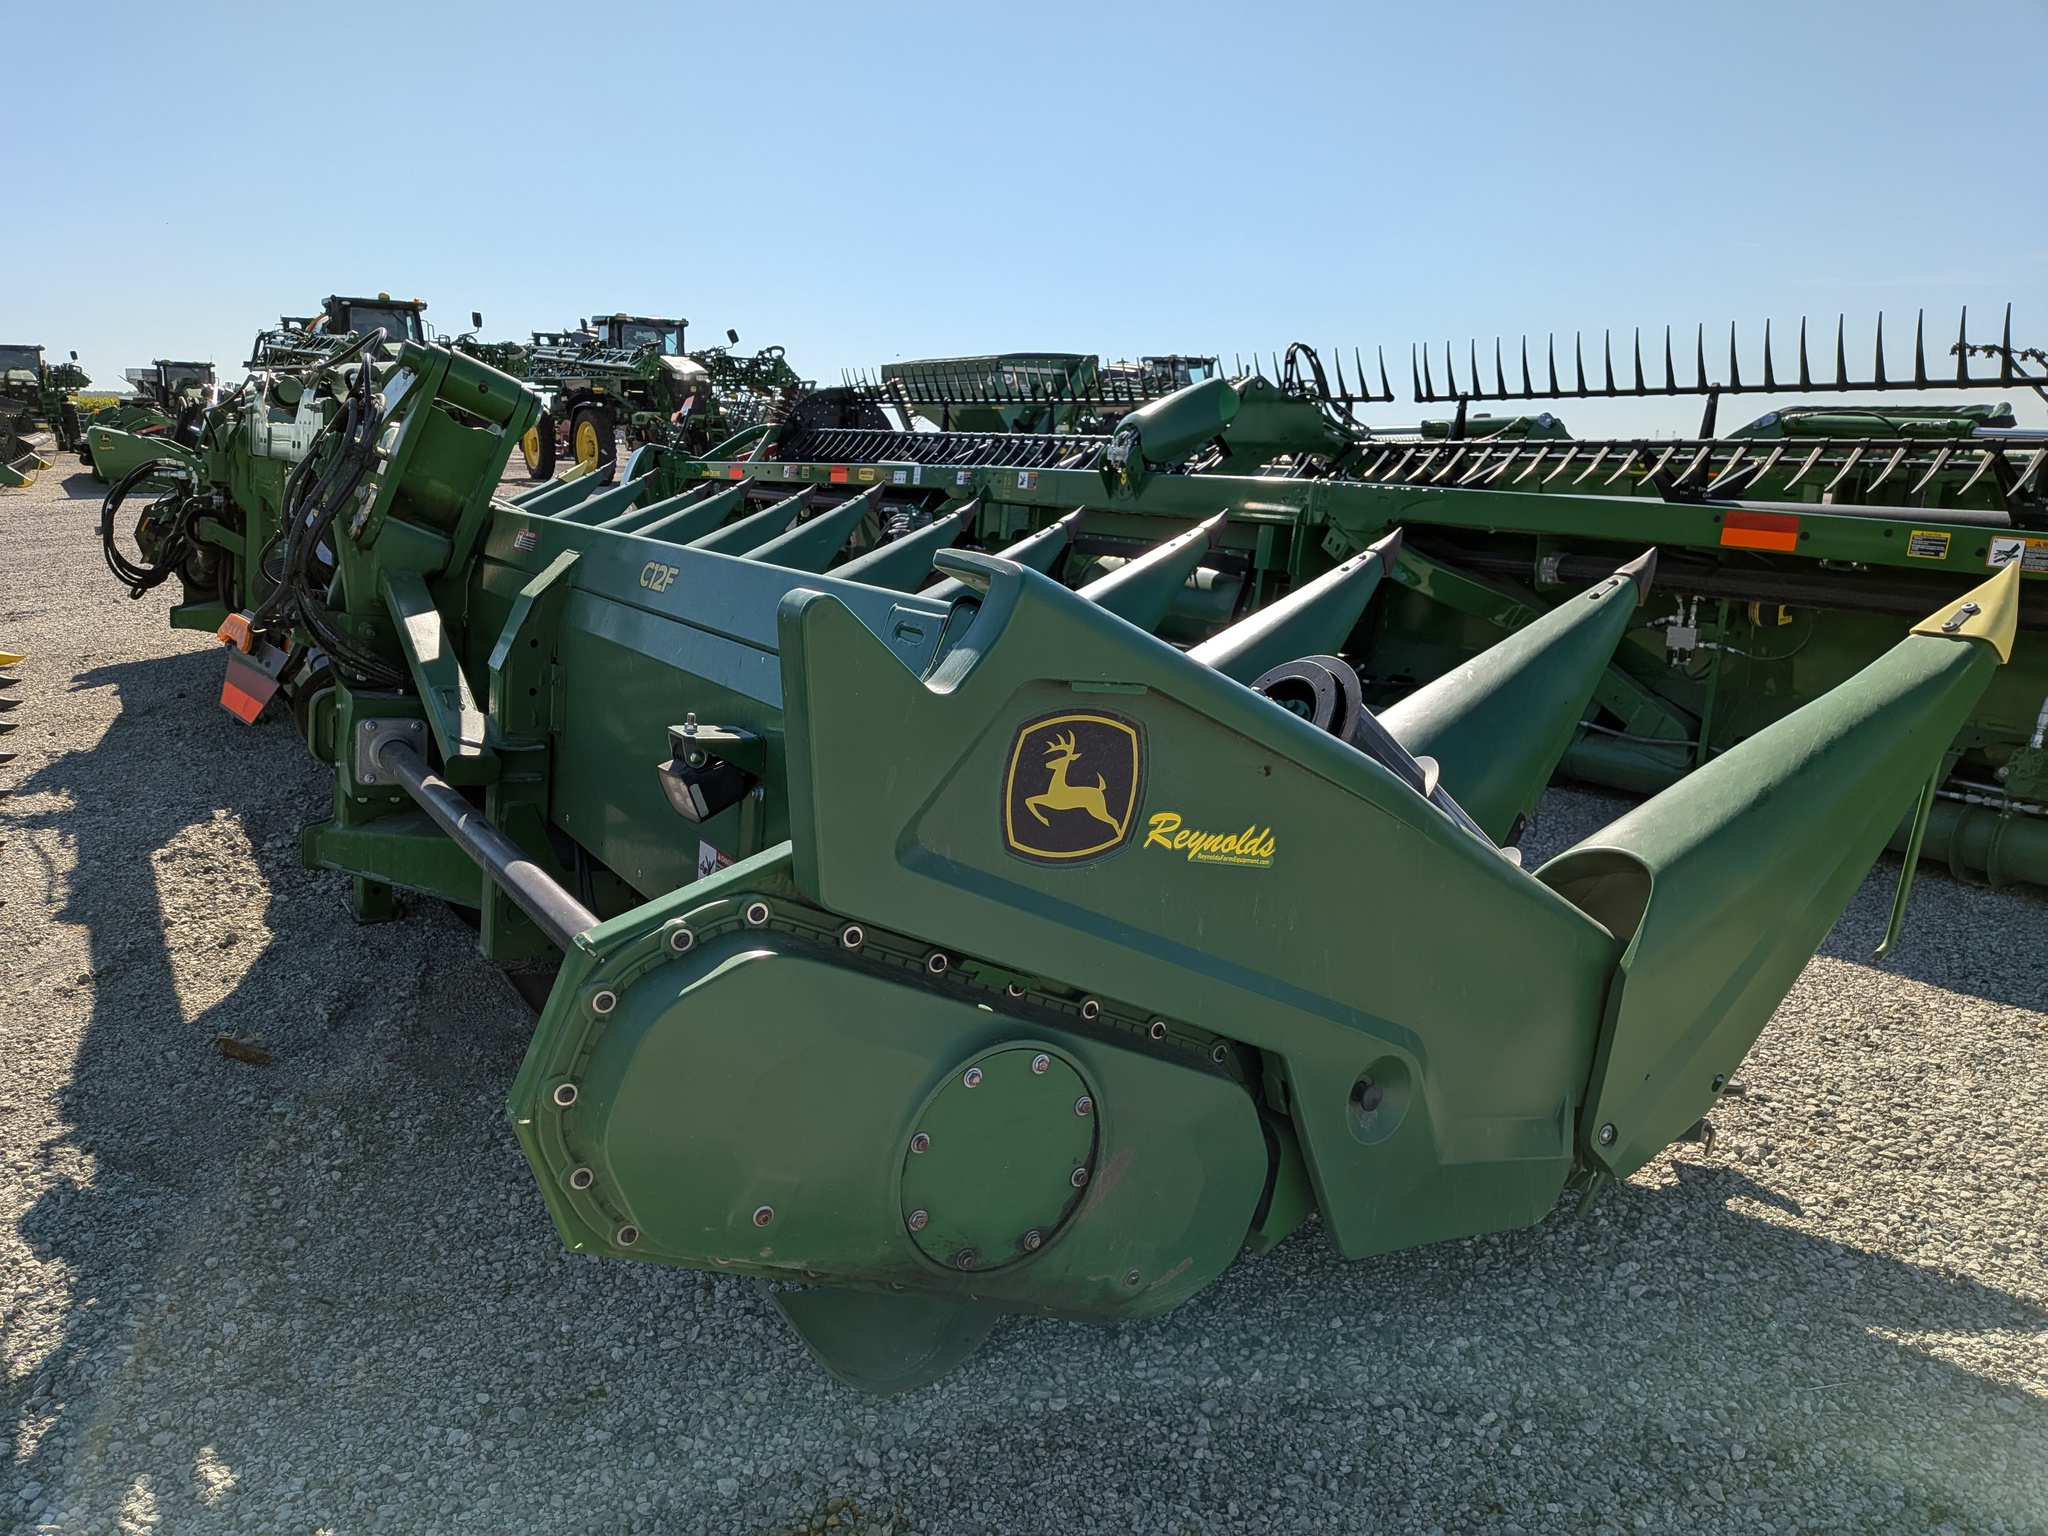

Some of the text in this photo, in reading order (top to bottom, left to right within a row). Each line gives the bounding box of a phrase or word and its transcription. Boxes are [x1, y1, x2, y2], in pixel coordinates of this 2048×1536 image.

[639, 561, 680, 593] C12F
[1143, 812, 1276, 861] Reynolds
[1197, 852, 1270, 865] ReynoldsFarmEquipment.com
